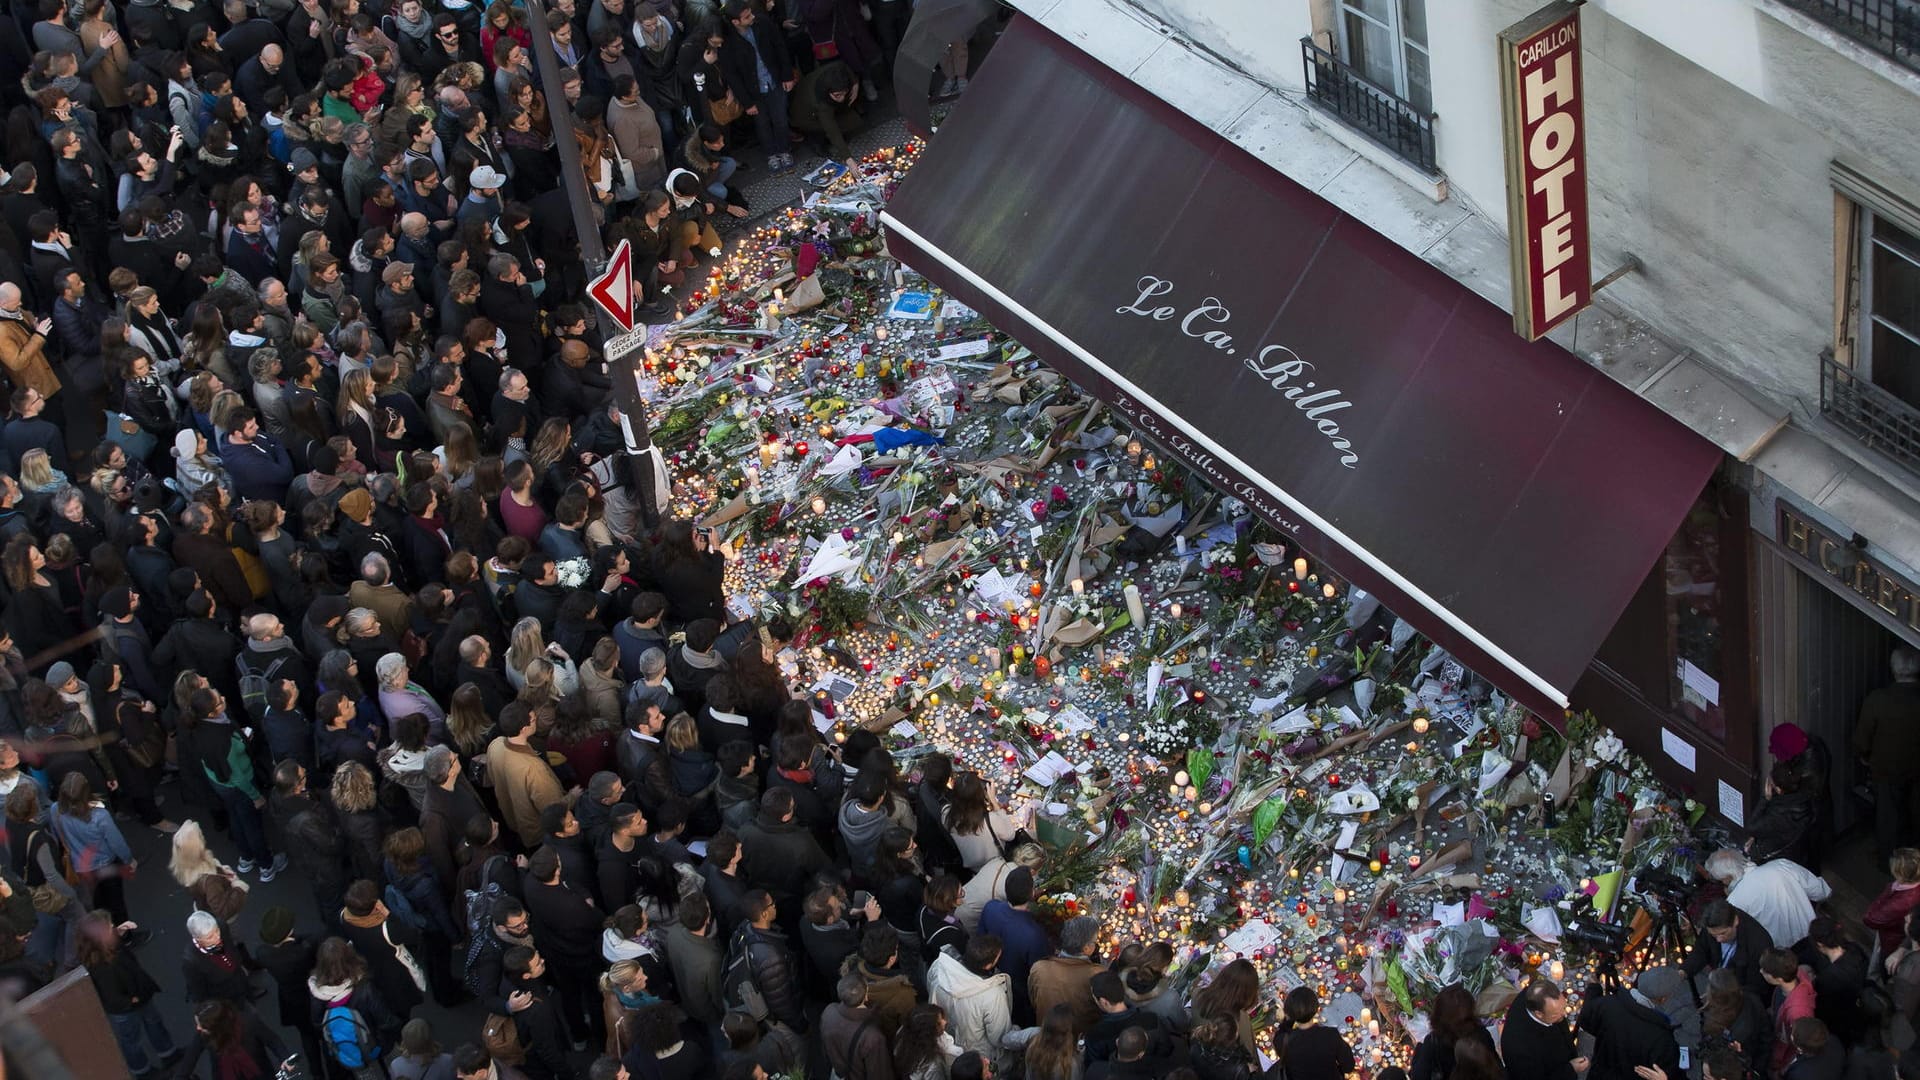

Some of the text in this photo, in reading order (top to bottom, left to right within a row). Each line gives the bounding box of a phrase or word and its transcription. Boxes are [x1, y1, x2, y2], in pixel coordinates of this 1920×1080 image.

[1519, 22, 1576, 69] CARILLON
[1525, 51, 1577, 323] HOTEL
[612, 337, 641, 356] PASSAGE
[1115, 275, 1176, 321] Le
[1243, 344, 1360, 469] Rillon
[1113, 394, 1136, 417] Le
[1170, 435, 1231, 485] Rillon
[1234, 482, 1302, 534] Bistrot
